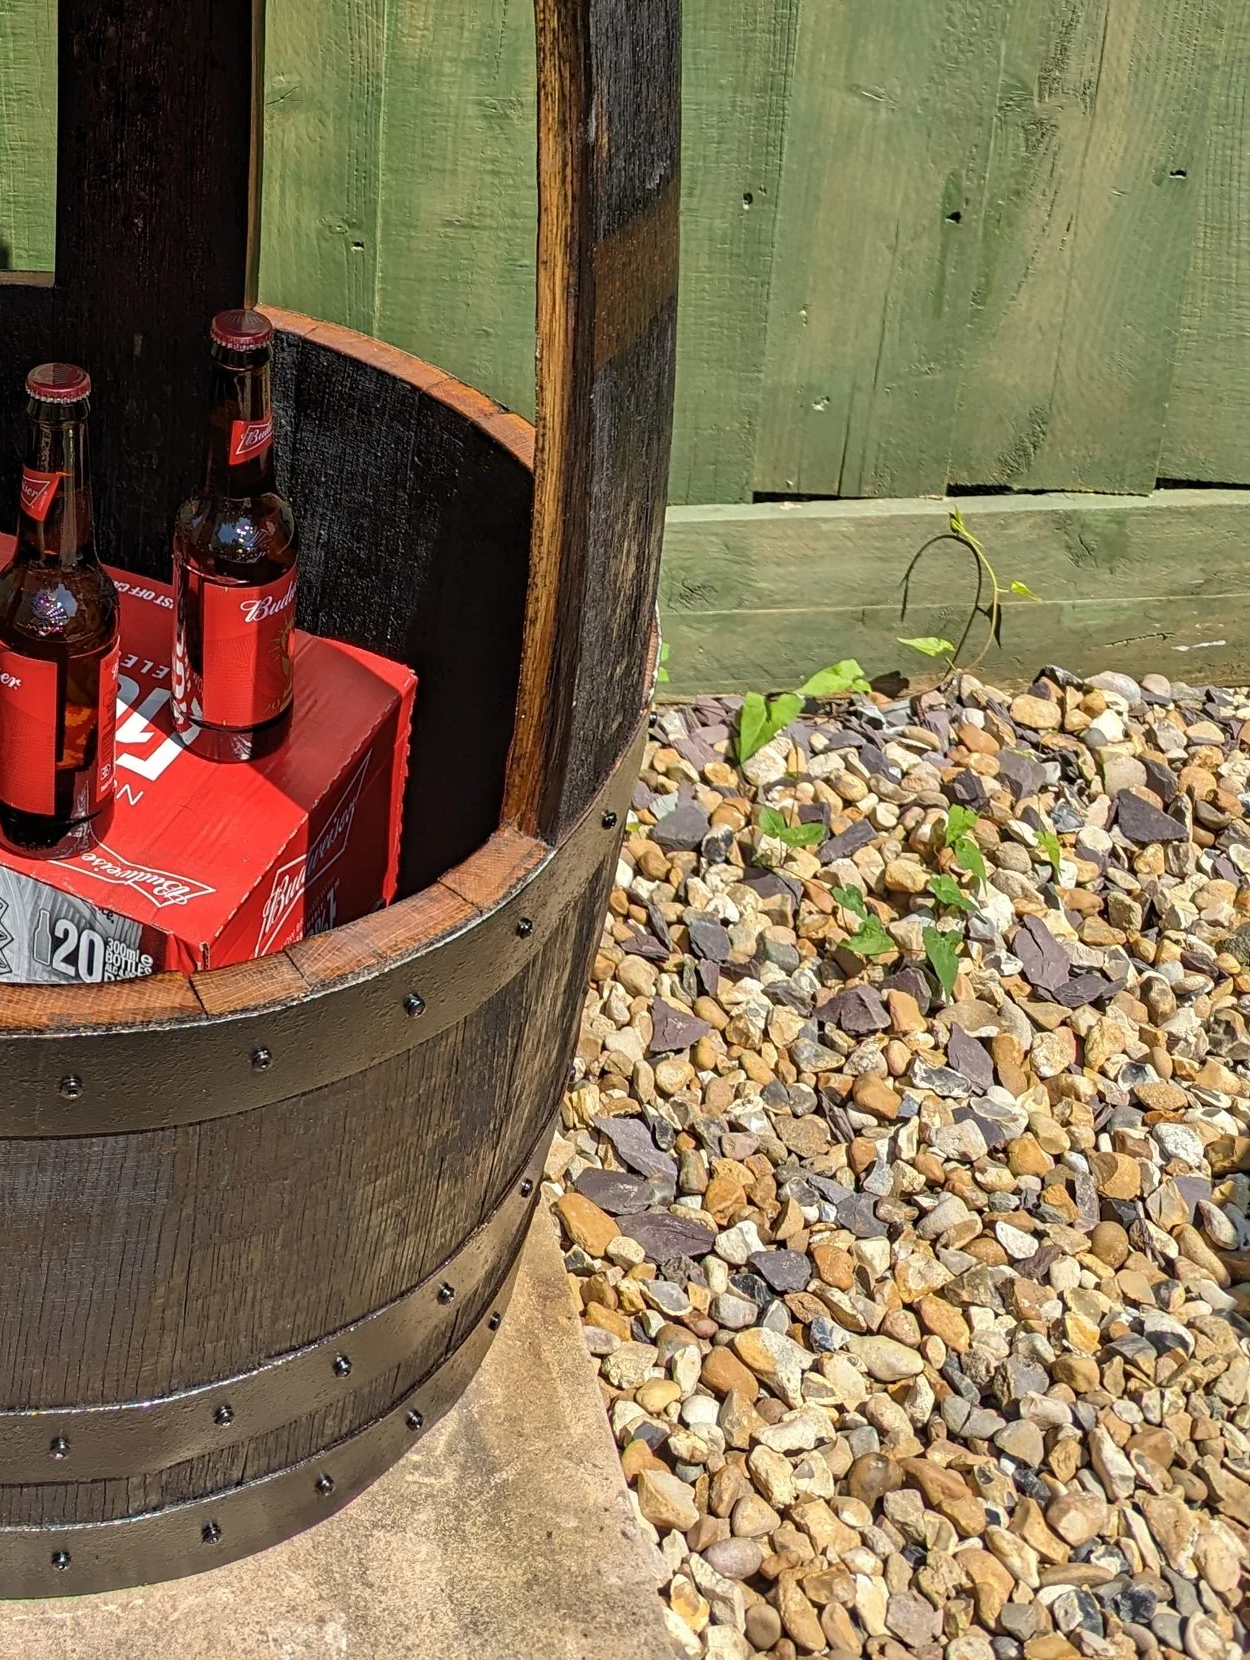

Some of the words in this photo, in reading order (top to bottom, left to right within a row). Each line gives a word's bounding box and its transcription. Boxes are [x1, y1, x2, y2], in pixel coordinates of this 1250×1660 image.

[81, 851, 191, 906] Budweise
[52, 918, 105, 983] 20
[106, 937, 140, 963] 300ml
